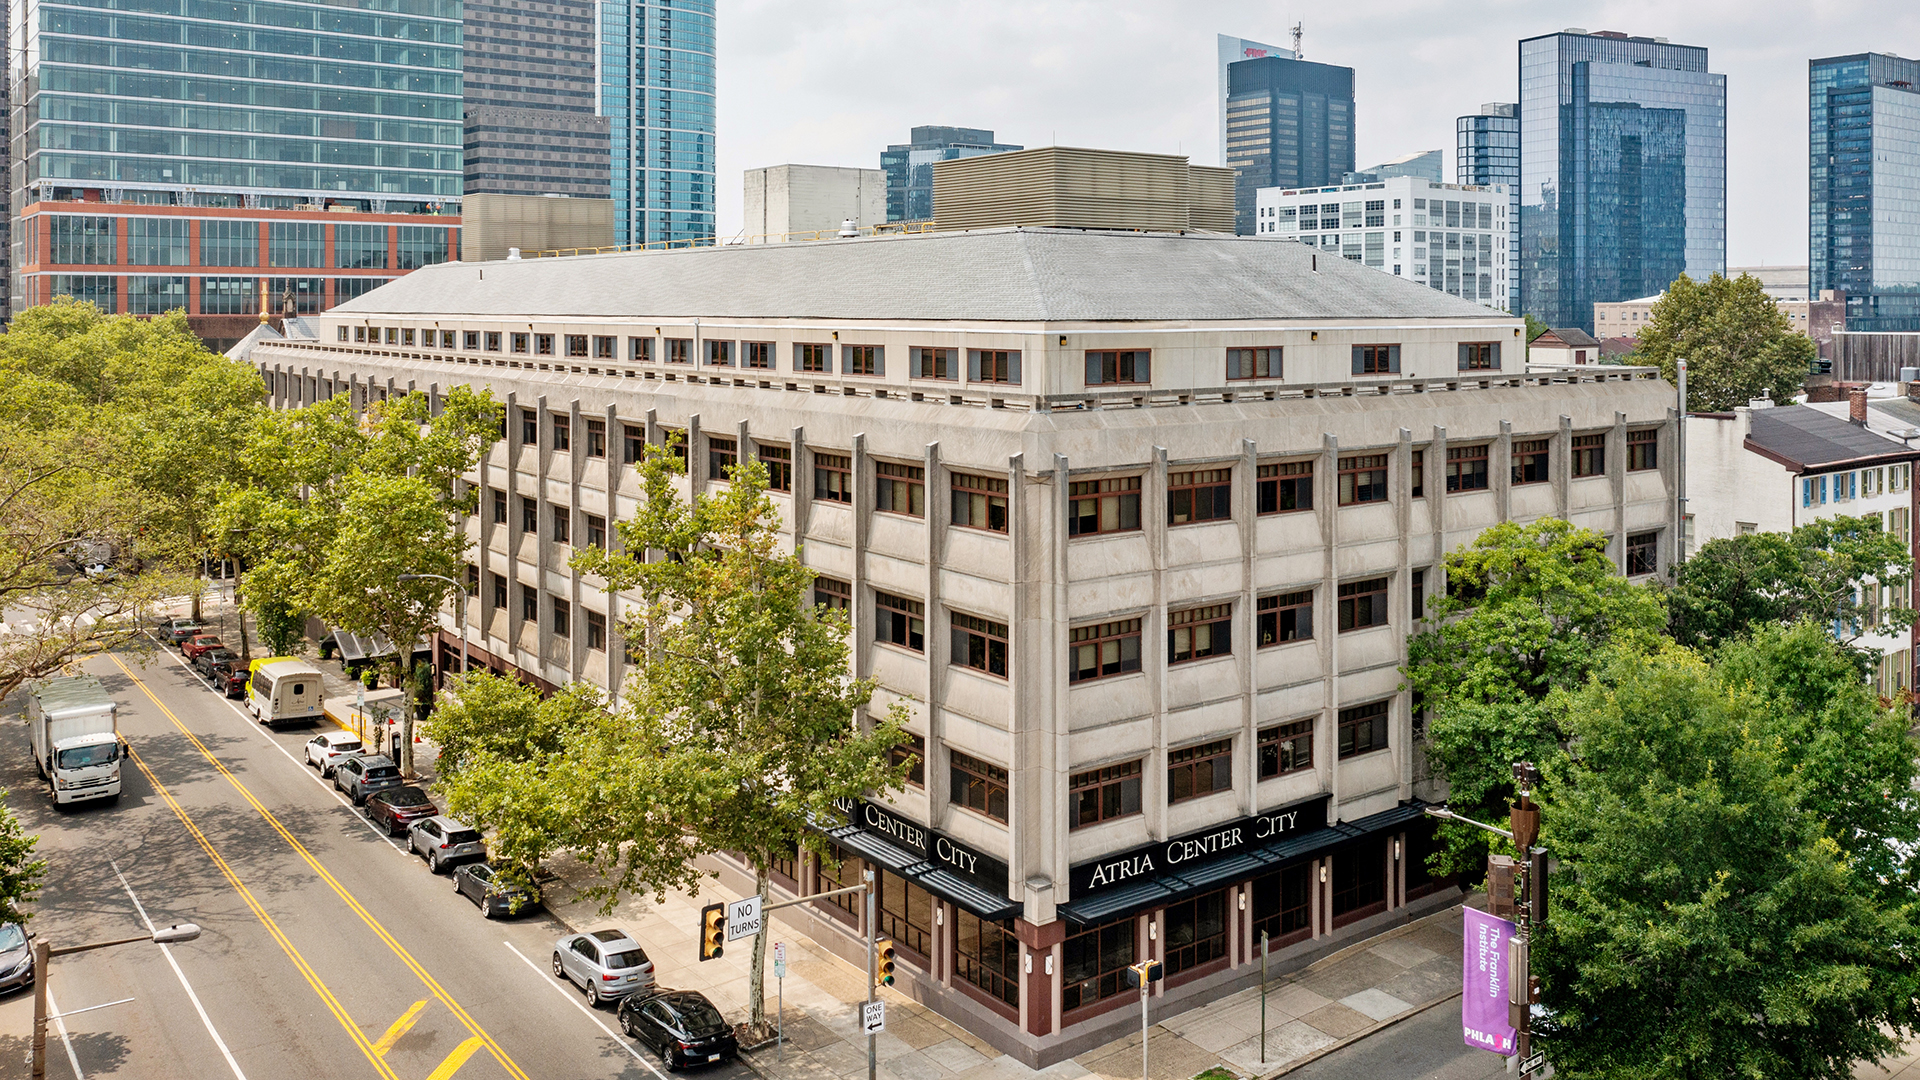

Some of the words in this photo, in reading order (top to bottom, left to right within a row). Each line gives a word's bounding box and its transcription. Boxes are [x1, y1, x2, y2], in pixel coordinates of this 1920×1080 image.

[865, 804, 926, 850] CENTER
[937, 837, 977, 874] CITY
[1088, 854, 1155, 889] ATRIA
[1167, 828, 1244, 864] CENTER
[1256, 811, 1298, 839] CITY
[737, 903, 753, 918] NO
[730, 918, 760, 935] TURNS
[1479, 922, 1489, 972] Institute
[1490, 928, 1500, 949] The
[1490, 951, 1500, 998] Franklin
[866, 1003, 883, 1014] ONE
[866, 1011, 883, 1022] WAY
[1464, 1027, 1511, 1049] PHLASH
